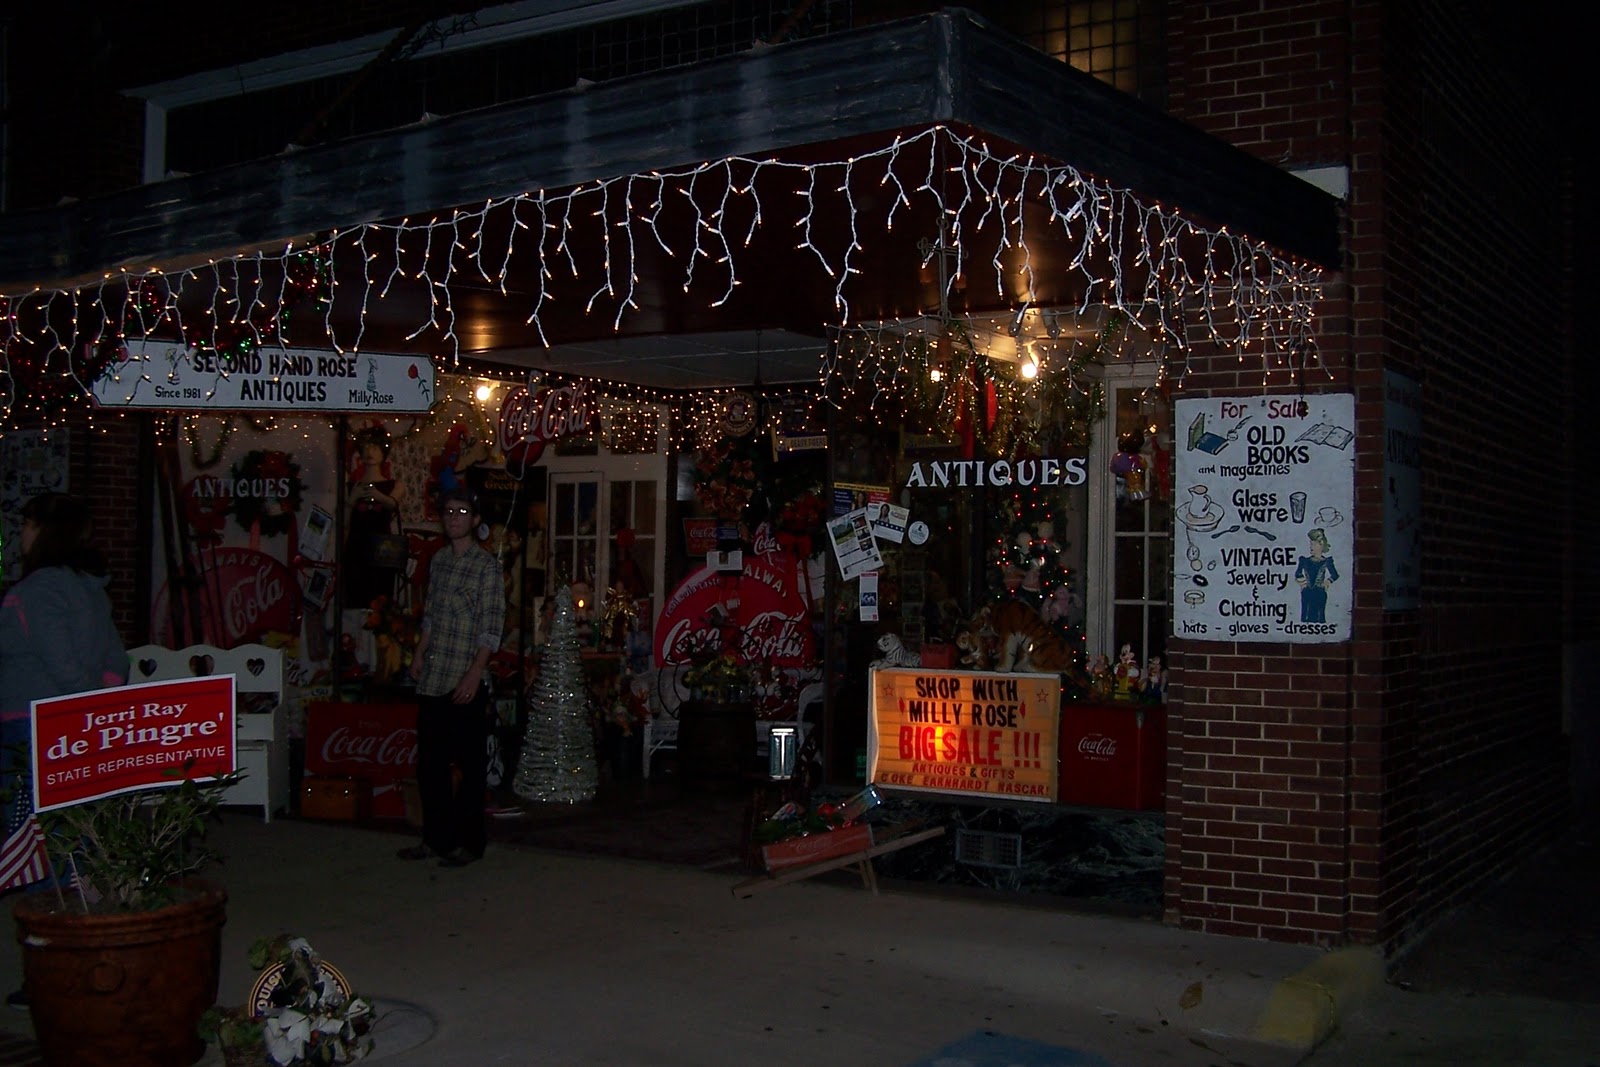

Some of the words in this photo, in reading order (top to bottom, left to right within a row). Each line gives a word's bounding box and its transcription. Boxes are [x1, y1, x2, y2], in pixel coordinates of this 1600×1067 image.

[193, 353, 262, 375] SECOND
[269, 354, 313, 377] HAND
[318, 355, 357, 378] ROSE
[155, 387, 181, 399] Since
[183, 388, 201, 399] 1981
[240, 379, 327, 402] ANTIQUES
[349, 389, 372, 406] Milly
[372, 393, 394, 405] Rose
[1220, 401, 1248, 419] For
[1247, 426, 1285, 446] OLD
[1247, 445, 1310, 466] BOOKS
[905, 457, 1087, 488] ANTIQUES
[1198, 464, 1215, 474] and
[1220, 463, 1290, 481] magazines
[191, 478, 290, 499] ANTIQUES
[1232, 489, 1277, 507] Glass
[1238, 505, 1288, 522] ware
[1220, 548, 1297, 567] VINTAGE
[1227, 569, 1288, 591] Jewelry
[224, 561, 284, 639] Cola
[1219, 599, 1287, 624] Clothing
[1183, 620, 1208, 635] hats
[1229, 621, 1269, 636] gloves
[915, 677, 960, 699] SHOP
[972, 679, 1018, 701] WITH
[82, 705, 136, 733] Jerri
[142, 702, 188, 718] Ray
[909, 701, 962, 725] MILLY
[972, 704, 1018, 728] ROSE
[47, 735, 89, 760] de
[321, 726, 419, 766] Coca-Col
[899, 725, 937, 761] BIG
[942, 728, 1003, 765] SALE
[46, 766, 92, 786] STATE
[97, 745, 226, 775] REPRESENTATIVE
[912, 762, 966, 776] ANTIQUES
[970, 767, 977, 778] &
[981, 768, 1015, 780] GIFTS
[881, 773, 913, 784] COKE
[923, 775, 990, 790] EARNHARDT
[998, 783, 1049, 796] NASCAR!
